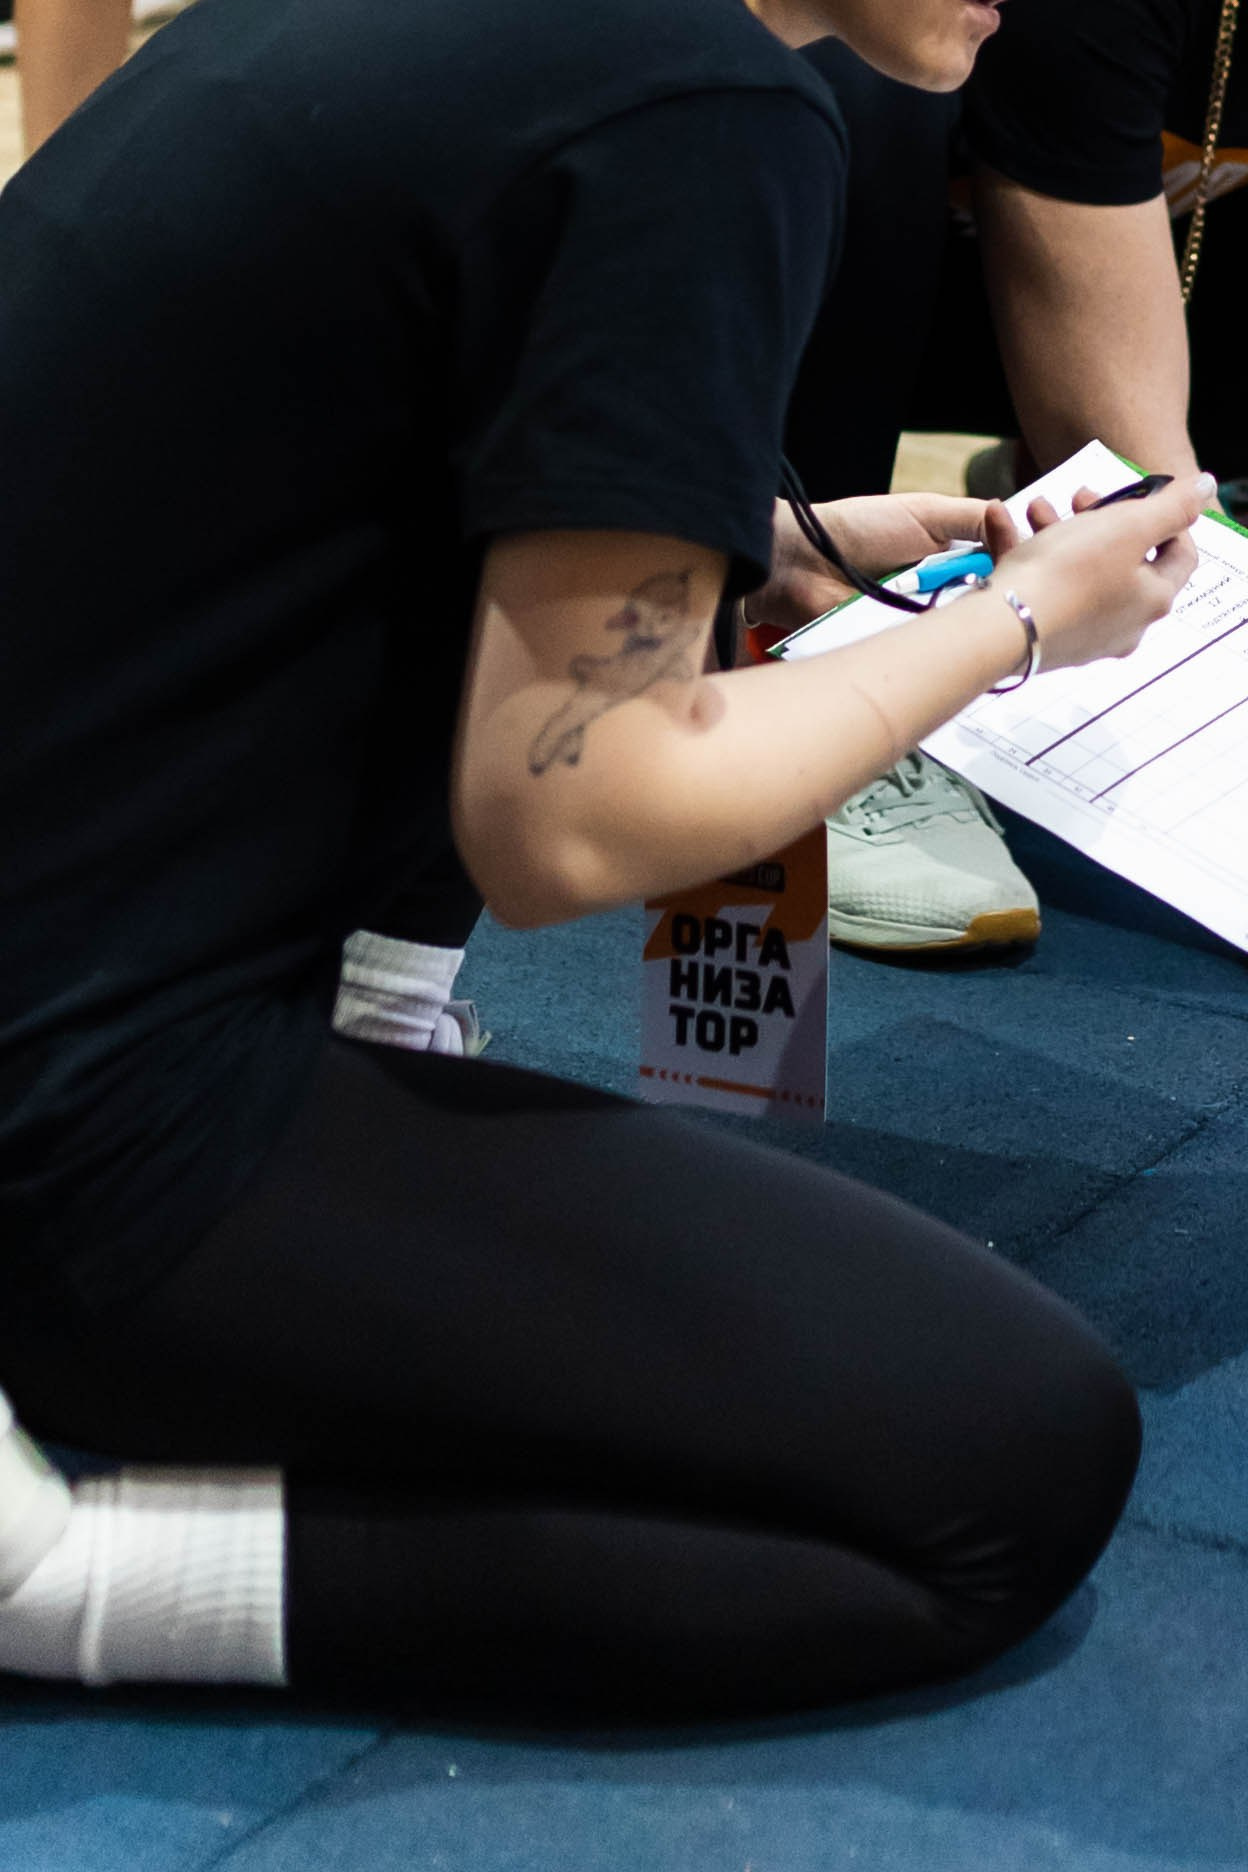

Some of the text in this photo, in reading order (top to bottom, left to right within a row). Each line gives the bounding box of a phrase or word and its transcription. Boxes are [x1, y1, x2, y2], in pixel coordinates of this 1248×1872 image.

[670, 913, 792, 971] ОРГА
[669, 958, 796, 1019] НИЗА
[668, 1004, 759, 1056] ТОР
